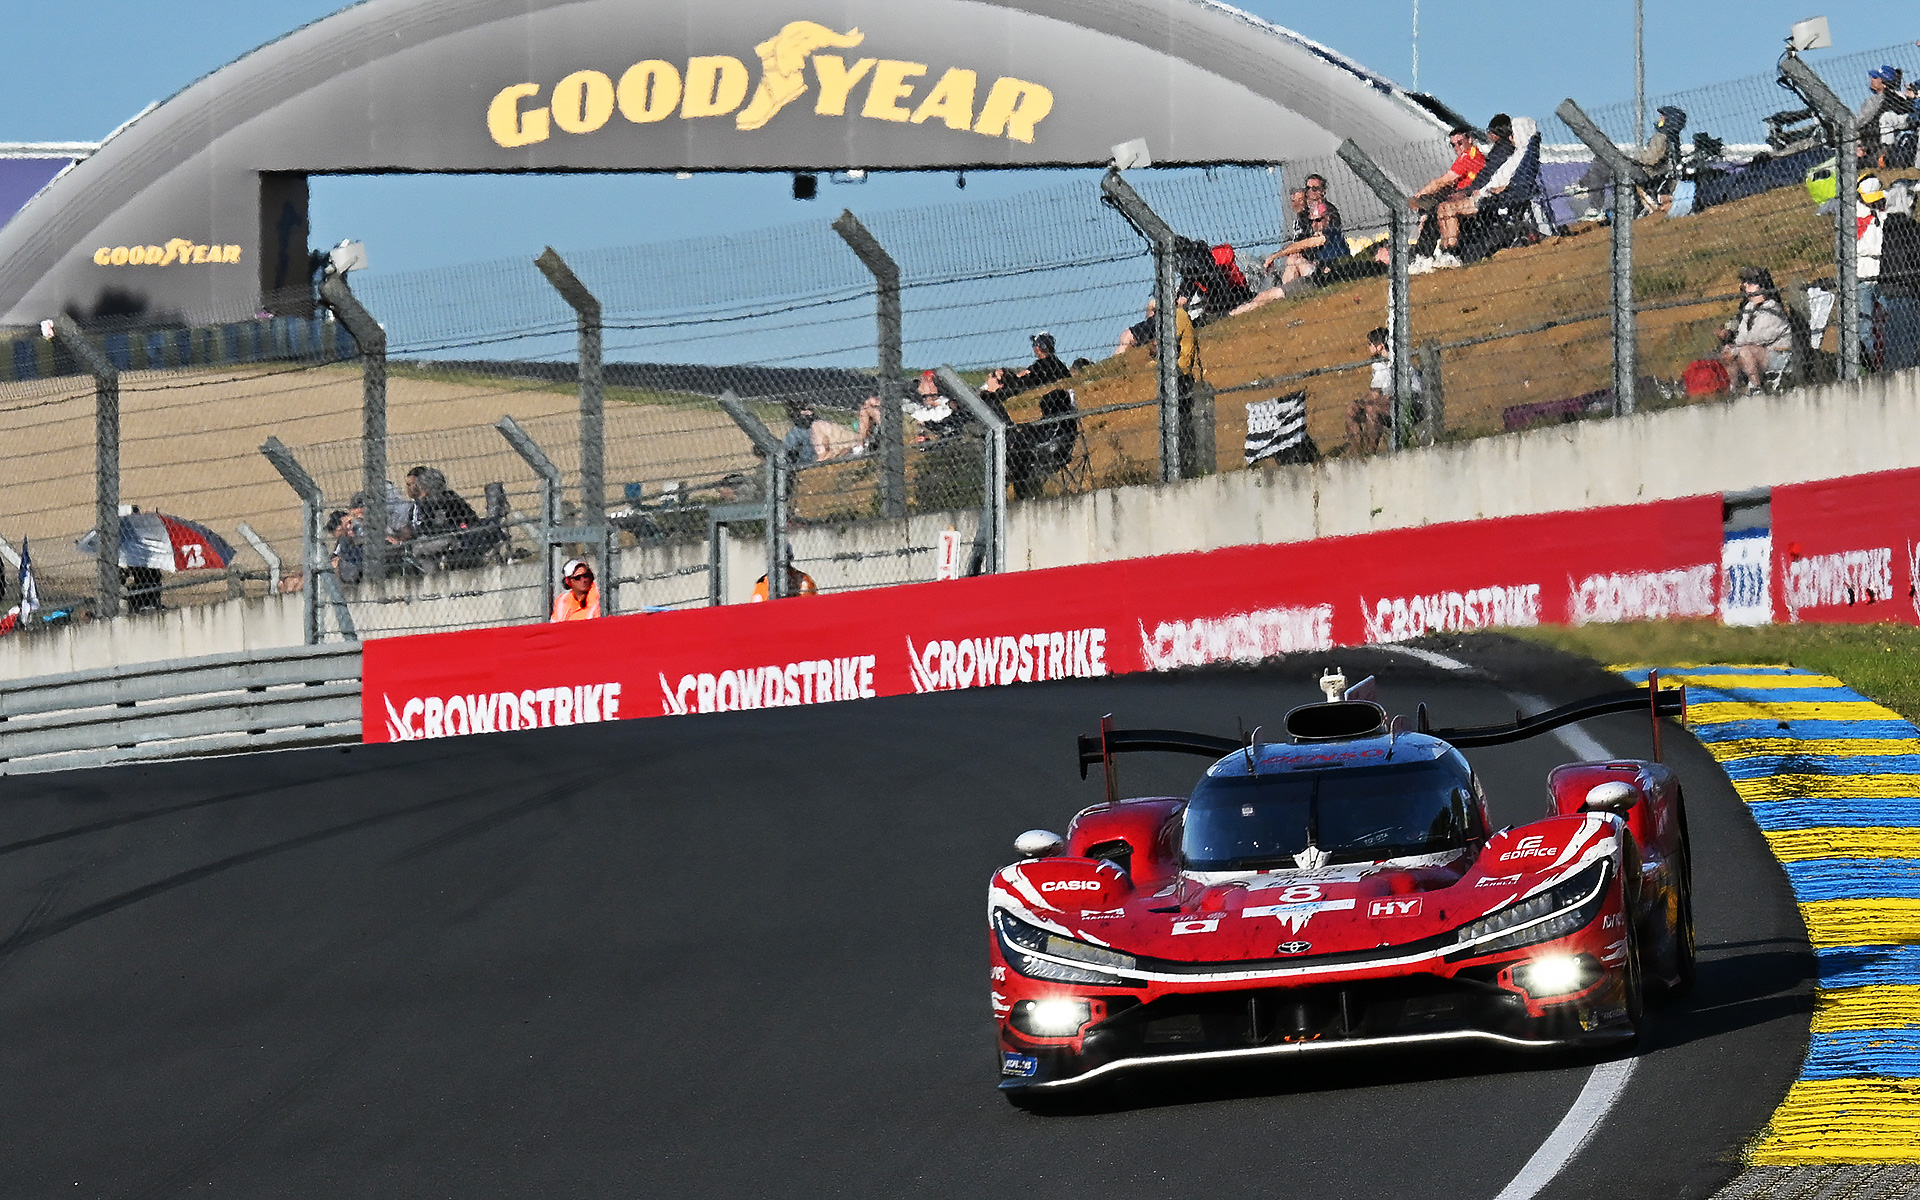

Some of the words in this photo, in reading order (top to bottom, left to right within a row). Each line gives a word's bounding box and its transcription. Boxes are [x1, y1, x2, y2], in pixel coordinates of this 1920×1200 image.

[487, 54, 1054, 148] GOODYEAR
[93, 244, 242, 266] GOODYEAR
[922, 628, 1107, 690] CROWDSTRIKE
[676, 654, 876, 715] CROWDSTRIKE
[401, 682, 621, 740] CROWDSTRIKE
[1260, 749, 1384, 764] DENSO
[1500, 847, 1557, 862] EDIFICE
[1041, 881, 1101, 892] CASIO
[1279, 885, 1322, 902] 8
[1372, 900, 1418, 916] HY
